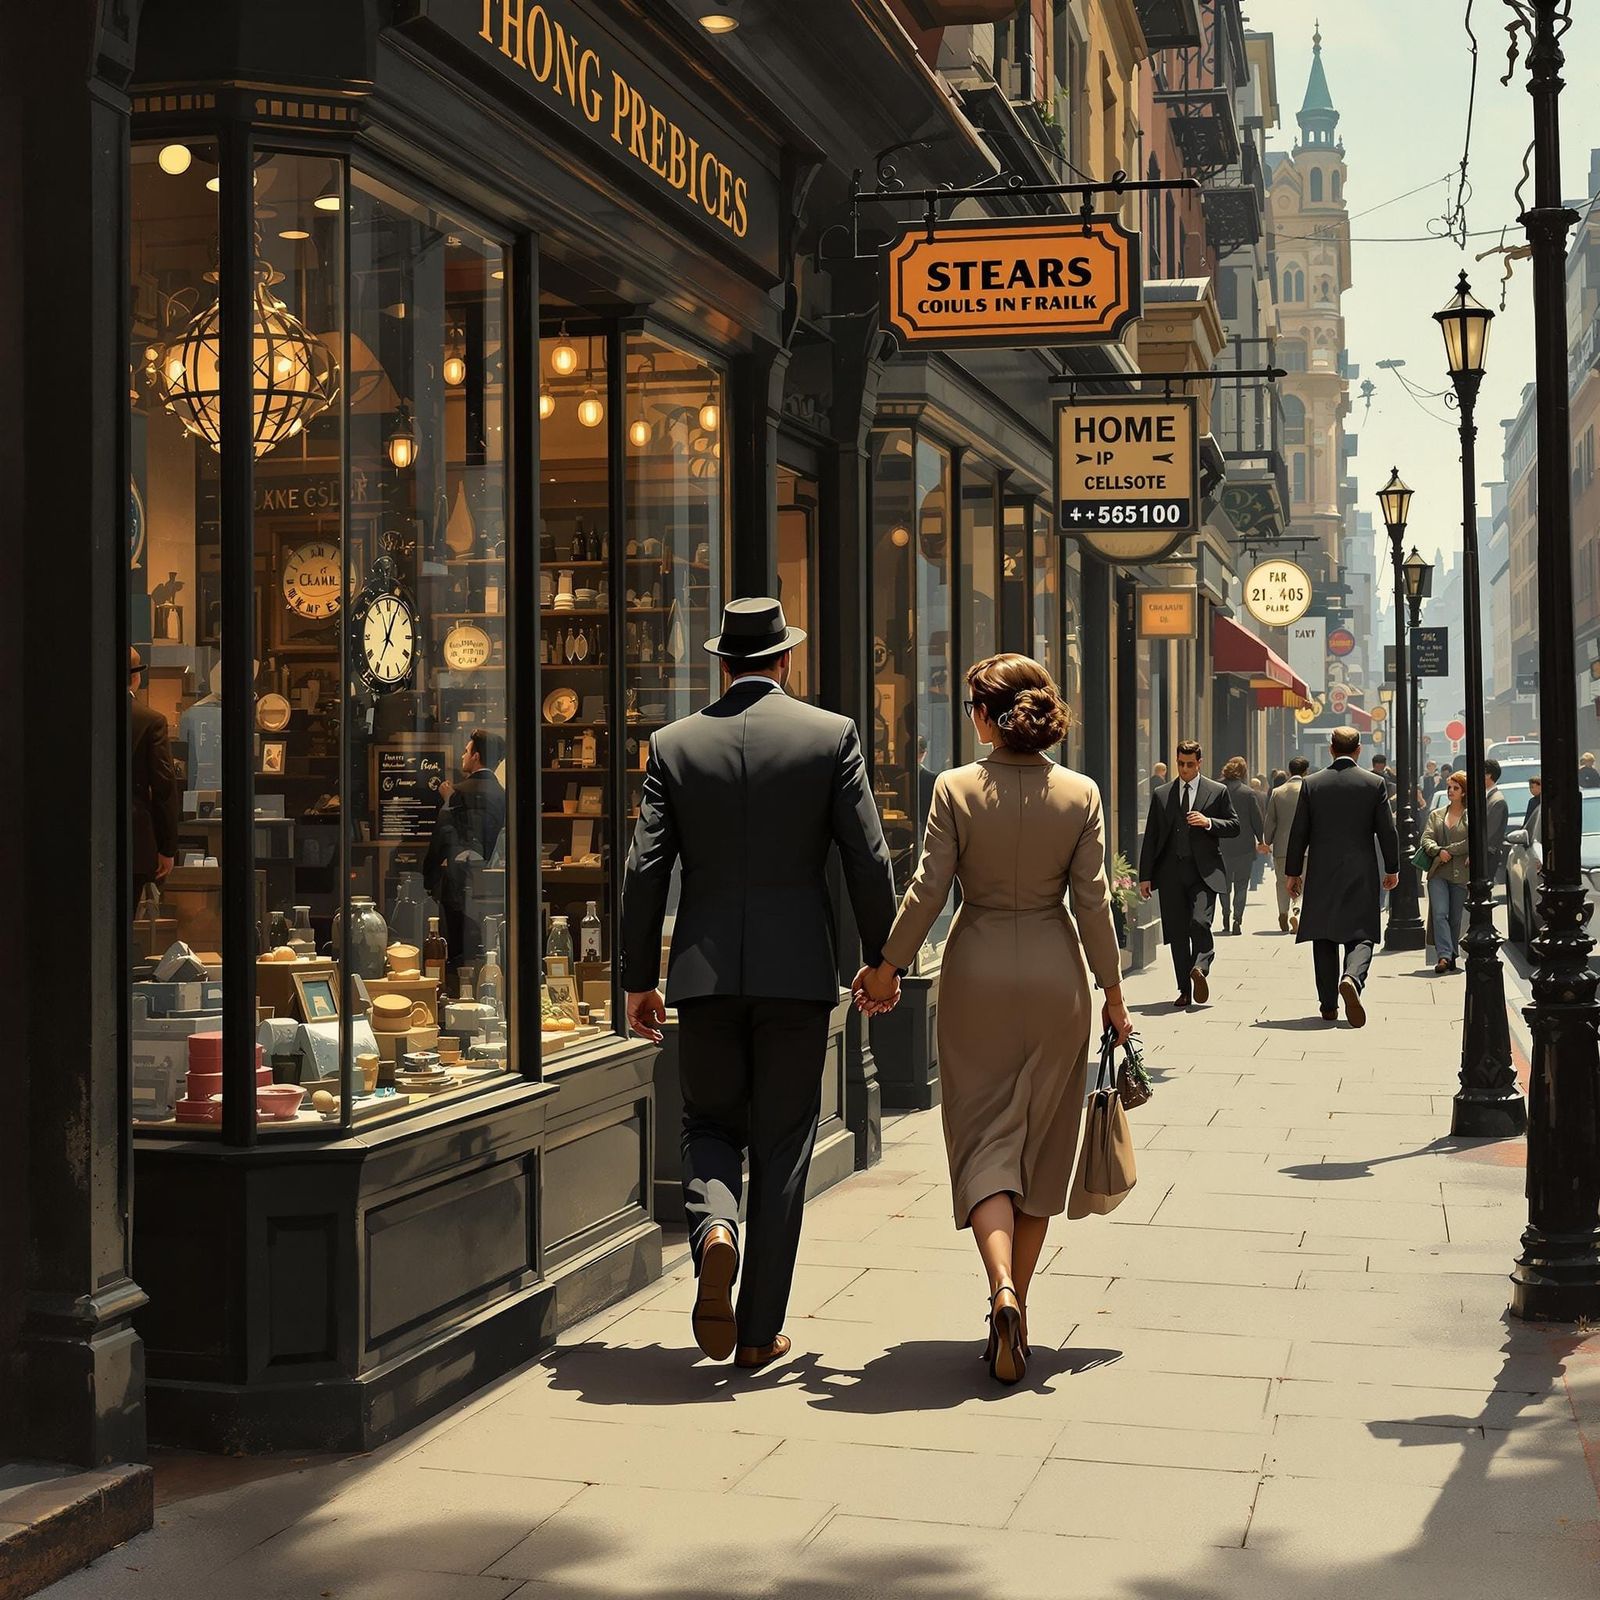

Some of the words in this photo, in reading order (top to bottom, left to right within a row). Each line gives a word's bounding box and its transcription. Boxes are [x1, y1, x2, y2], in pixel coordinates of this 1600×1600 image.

[610, 69, 748, 238] PREBICES
[927, 257, 1092, 292] STEARS
[917, 298, 988, 313] COIULS
[995, 297, 1016, 311] IN
[1074, 416, 1176, 443] HOME
[1096, 451, 1114, 465] IP
[1084, 475, 1167, 490] CELLSOTE
[1269, 572, 1287, 582] FAR
